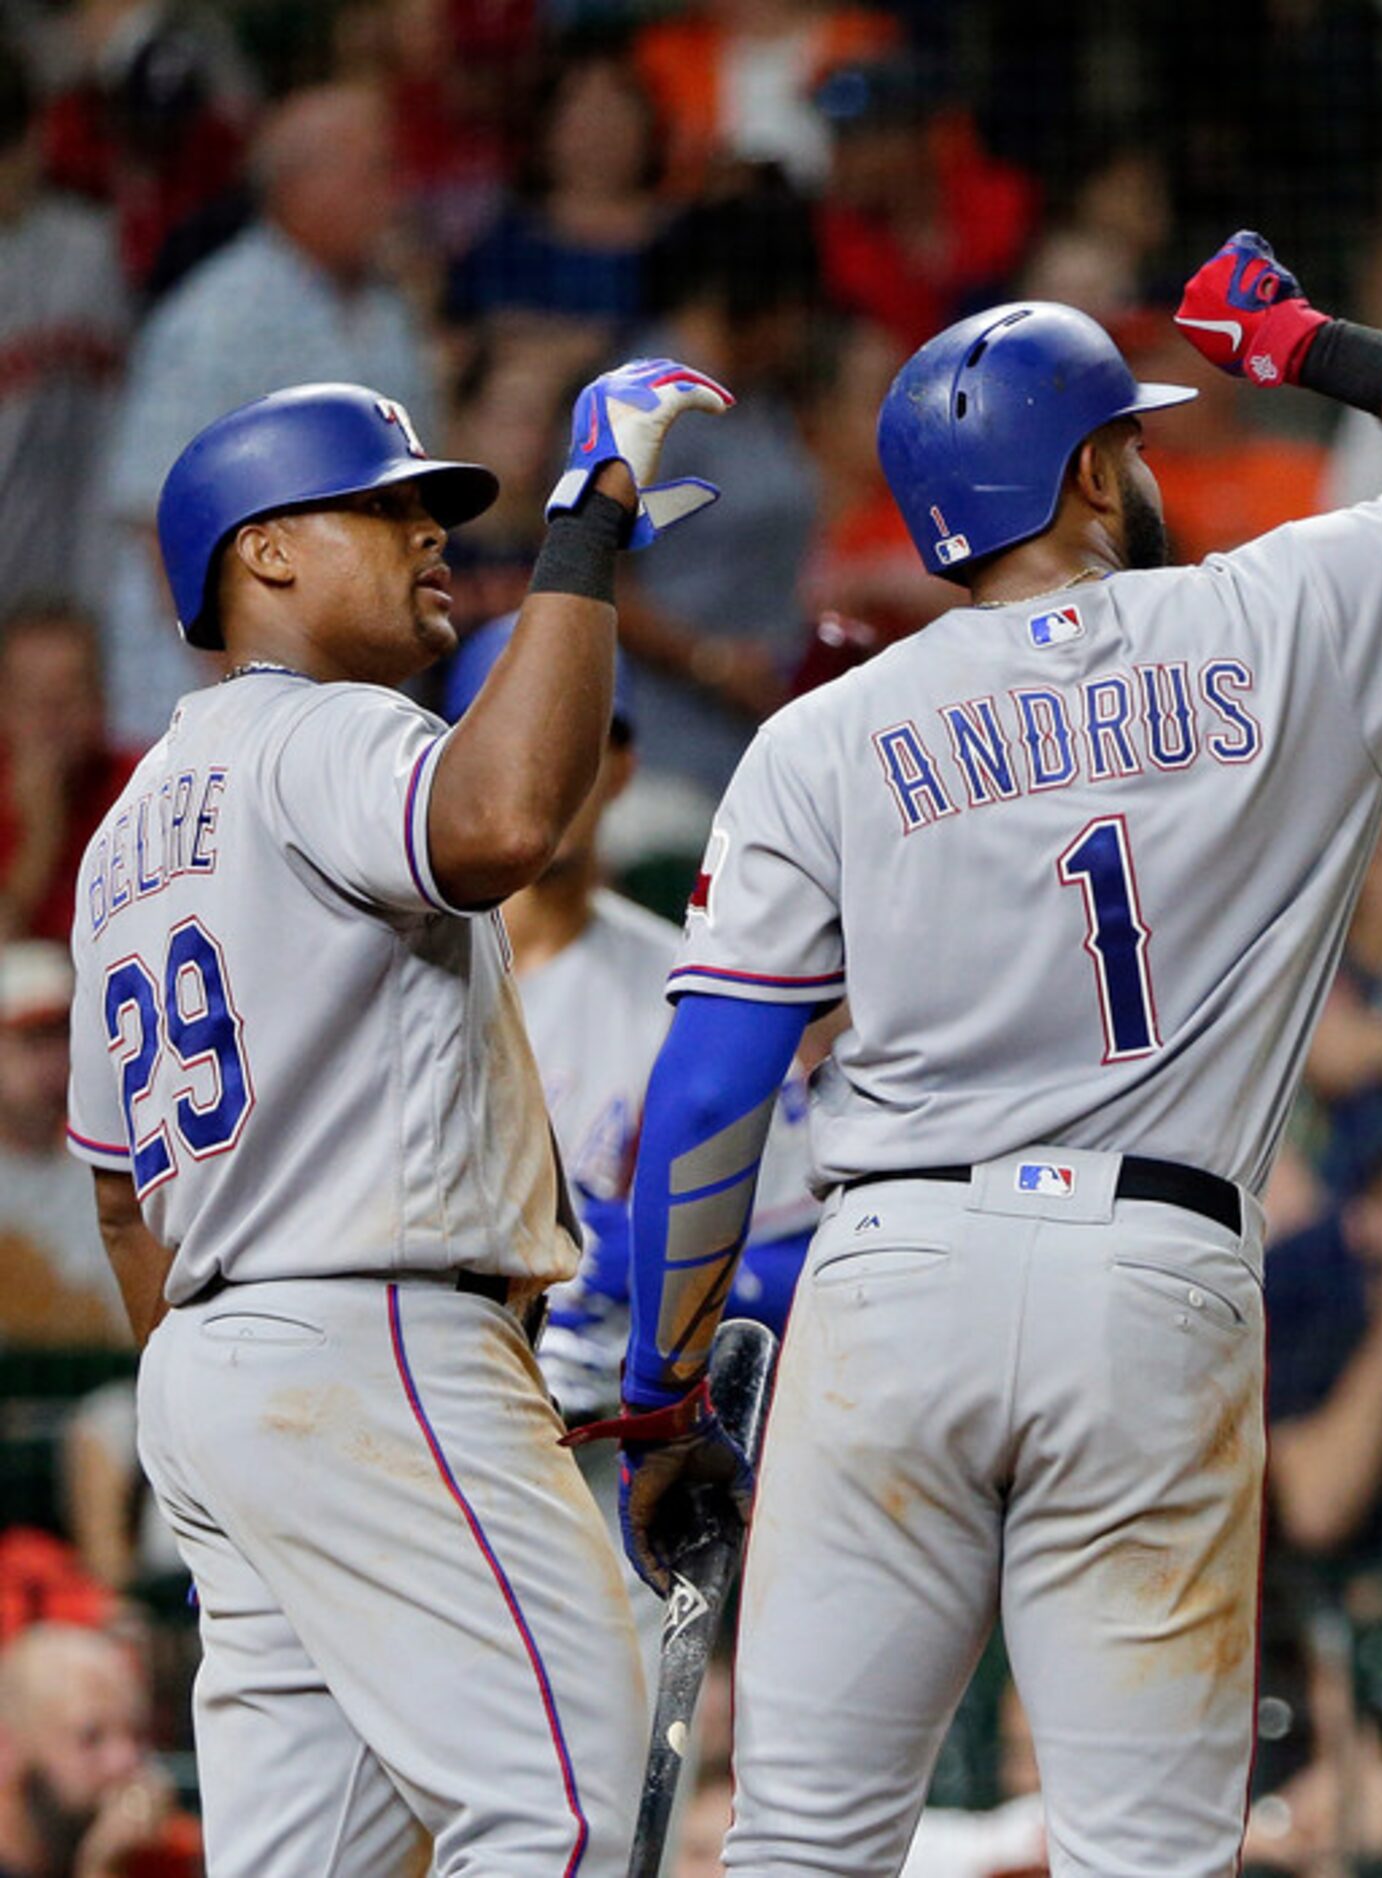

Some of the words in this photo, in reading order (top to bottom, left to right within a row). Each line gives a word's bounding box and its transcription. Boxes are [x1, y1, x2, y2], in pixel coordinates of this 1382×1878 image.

[930, 505, 950, 537] 1
[872, 658, 1263, 836] ANDRUS
[1057, 813, 1165, 1066] 1
[104, 914, 257, 1200] 29
